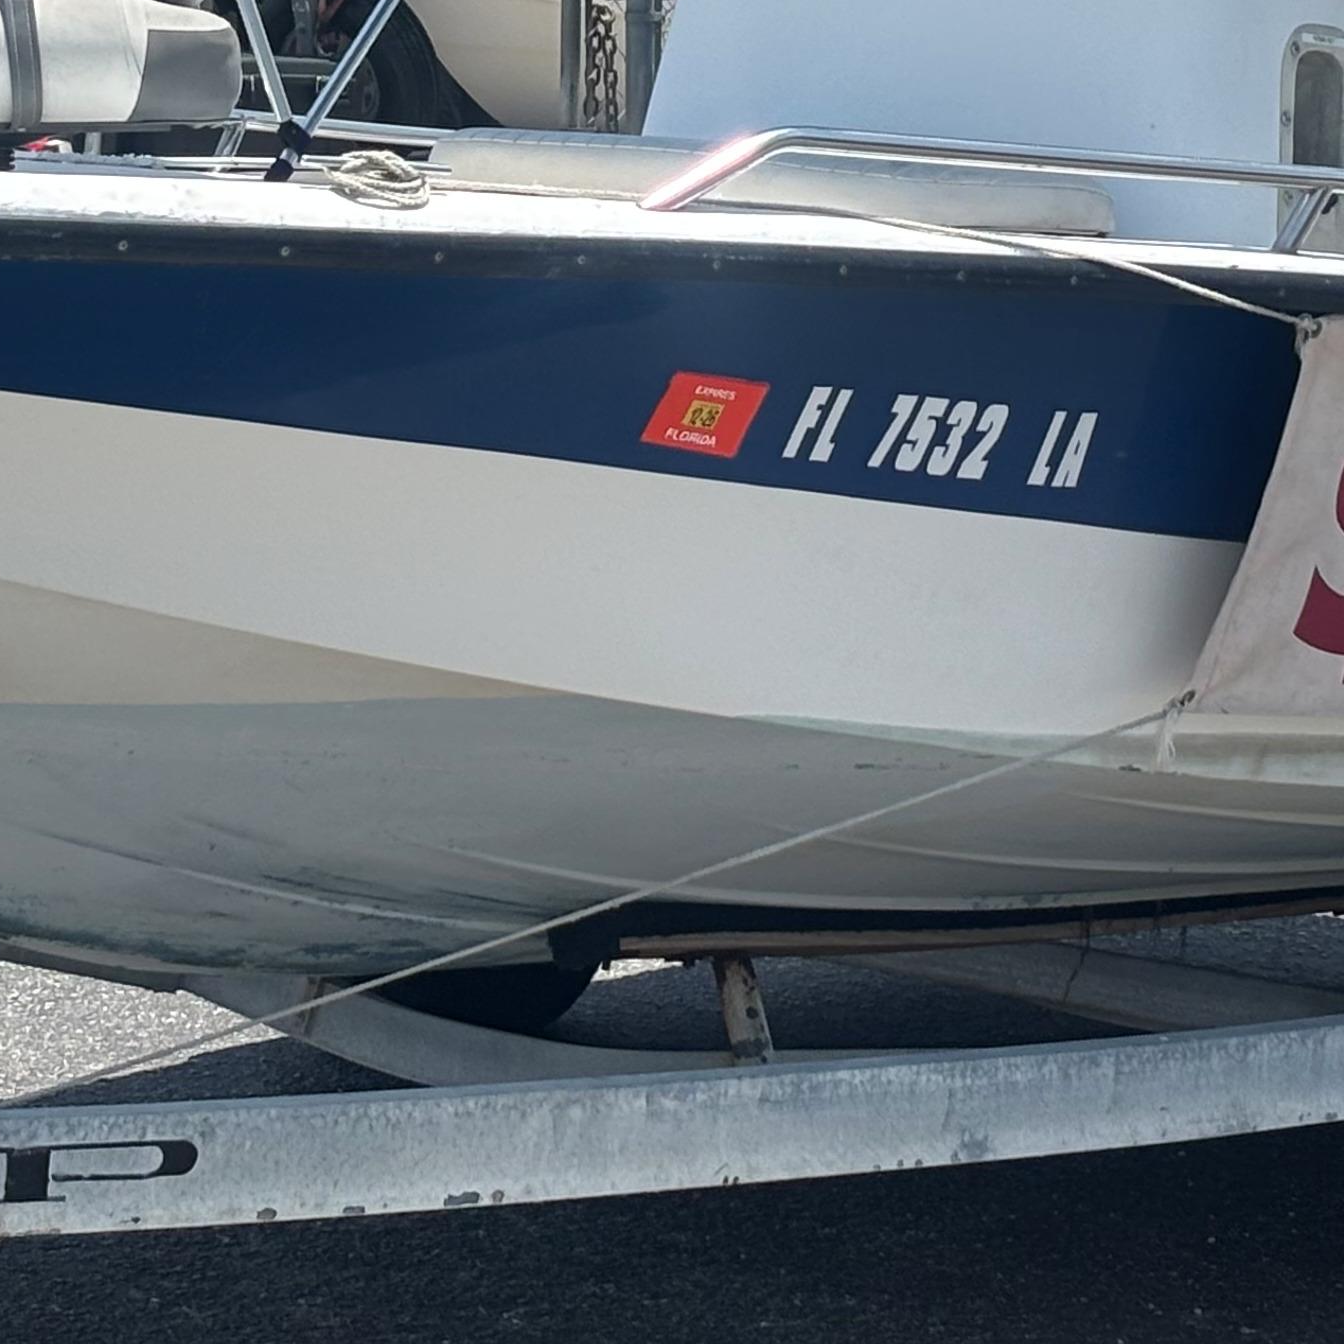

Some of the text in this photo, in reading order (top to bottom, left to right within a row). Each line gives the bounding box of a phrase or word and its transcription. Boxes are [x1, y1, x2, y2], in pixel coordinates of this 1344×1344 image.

[664, 427, 716, 448] FLORIDA
[782, 386, 1099, 488] FL 7532 LA
